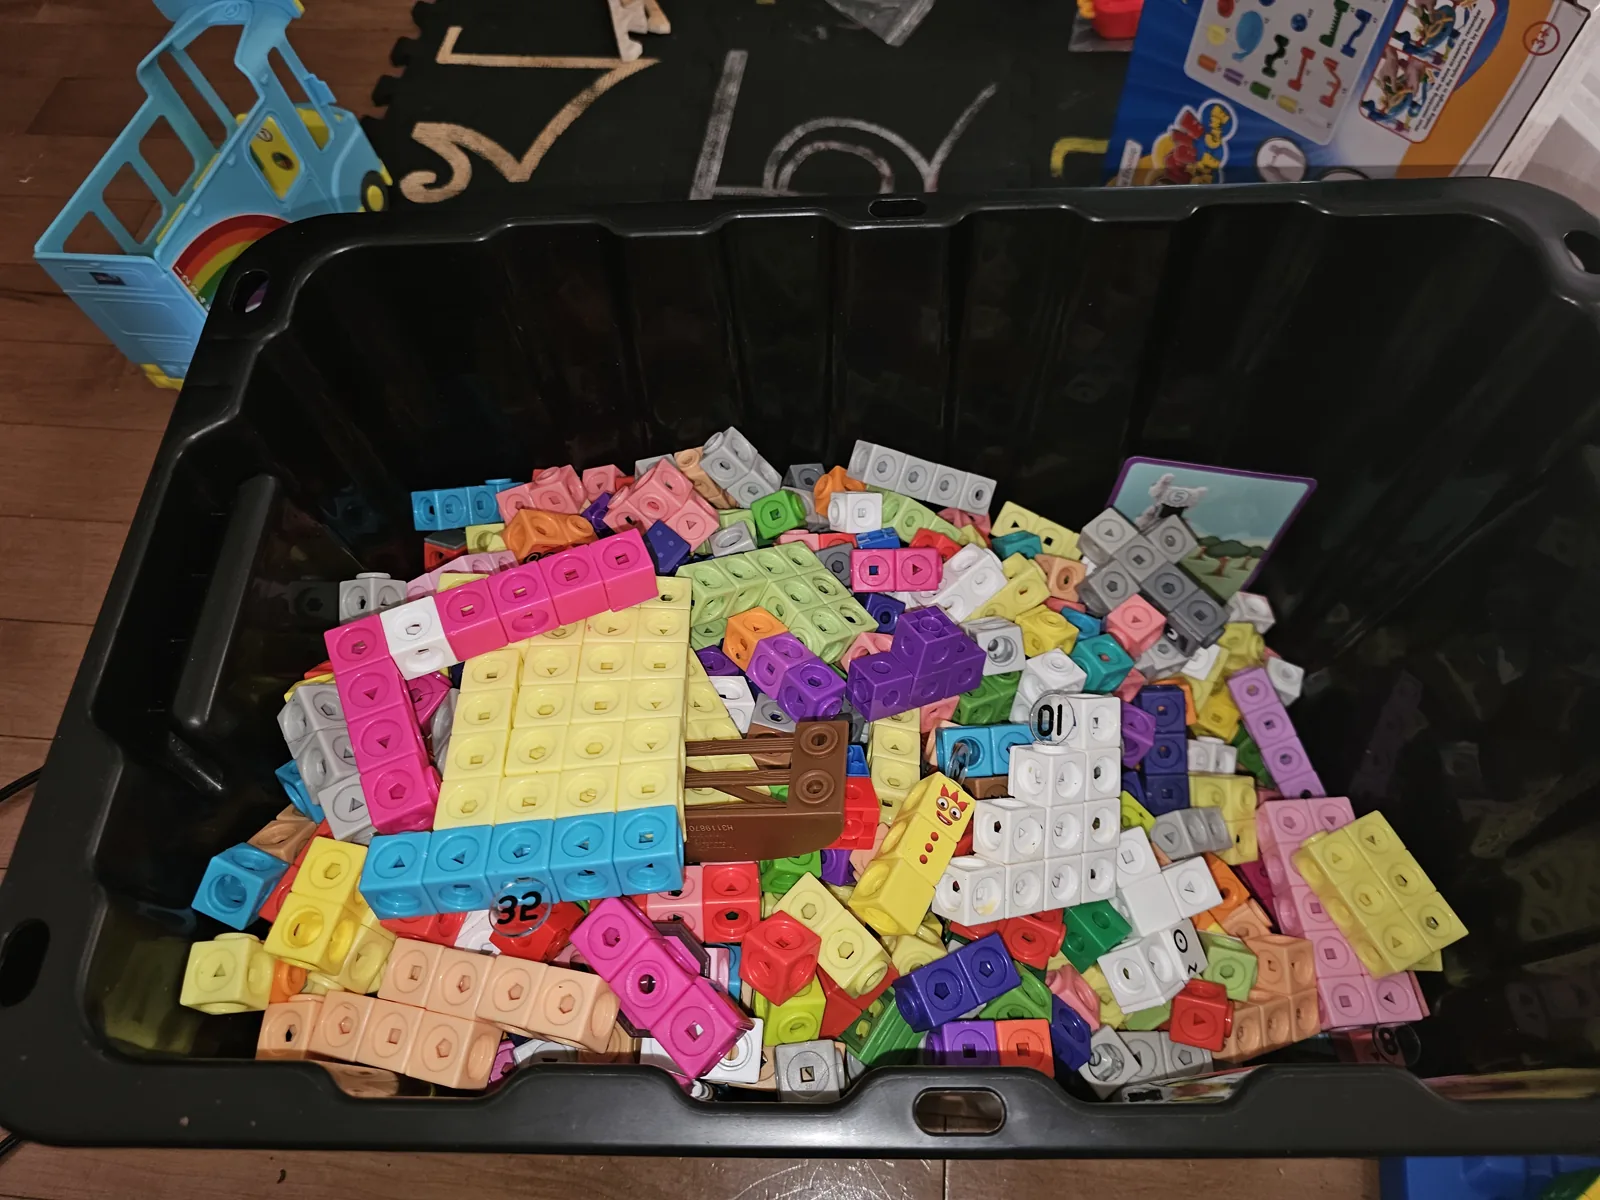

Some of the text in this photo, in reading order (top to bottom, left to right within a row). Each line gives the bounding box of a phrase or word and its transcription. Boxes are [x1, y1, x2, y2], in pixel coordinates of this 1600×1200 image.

[1531, 29, 1550, 49] 3+
[1172, 492, 1185, 502] 5
[497, 891, 542, 924] 32
